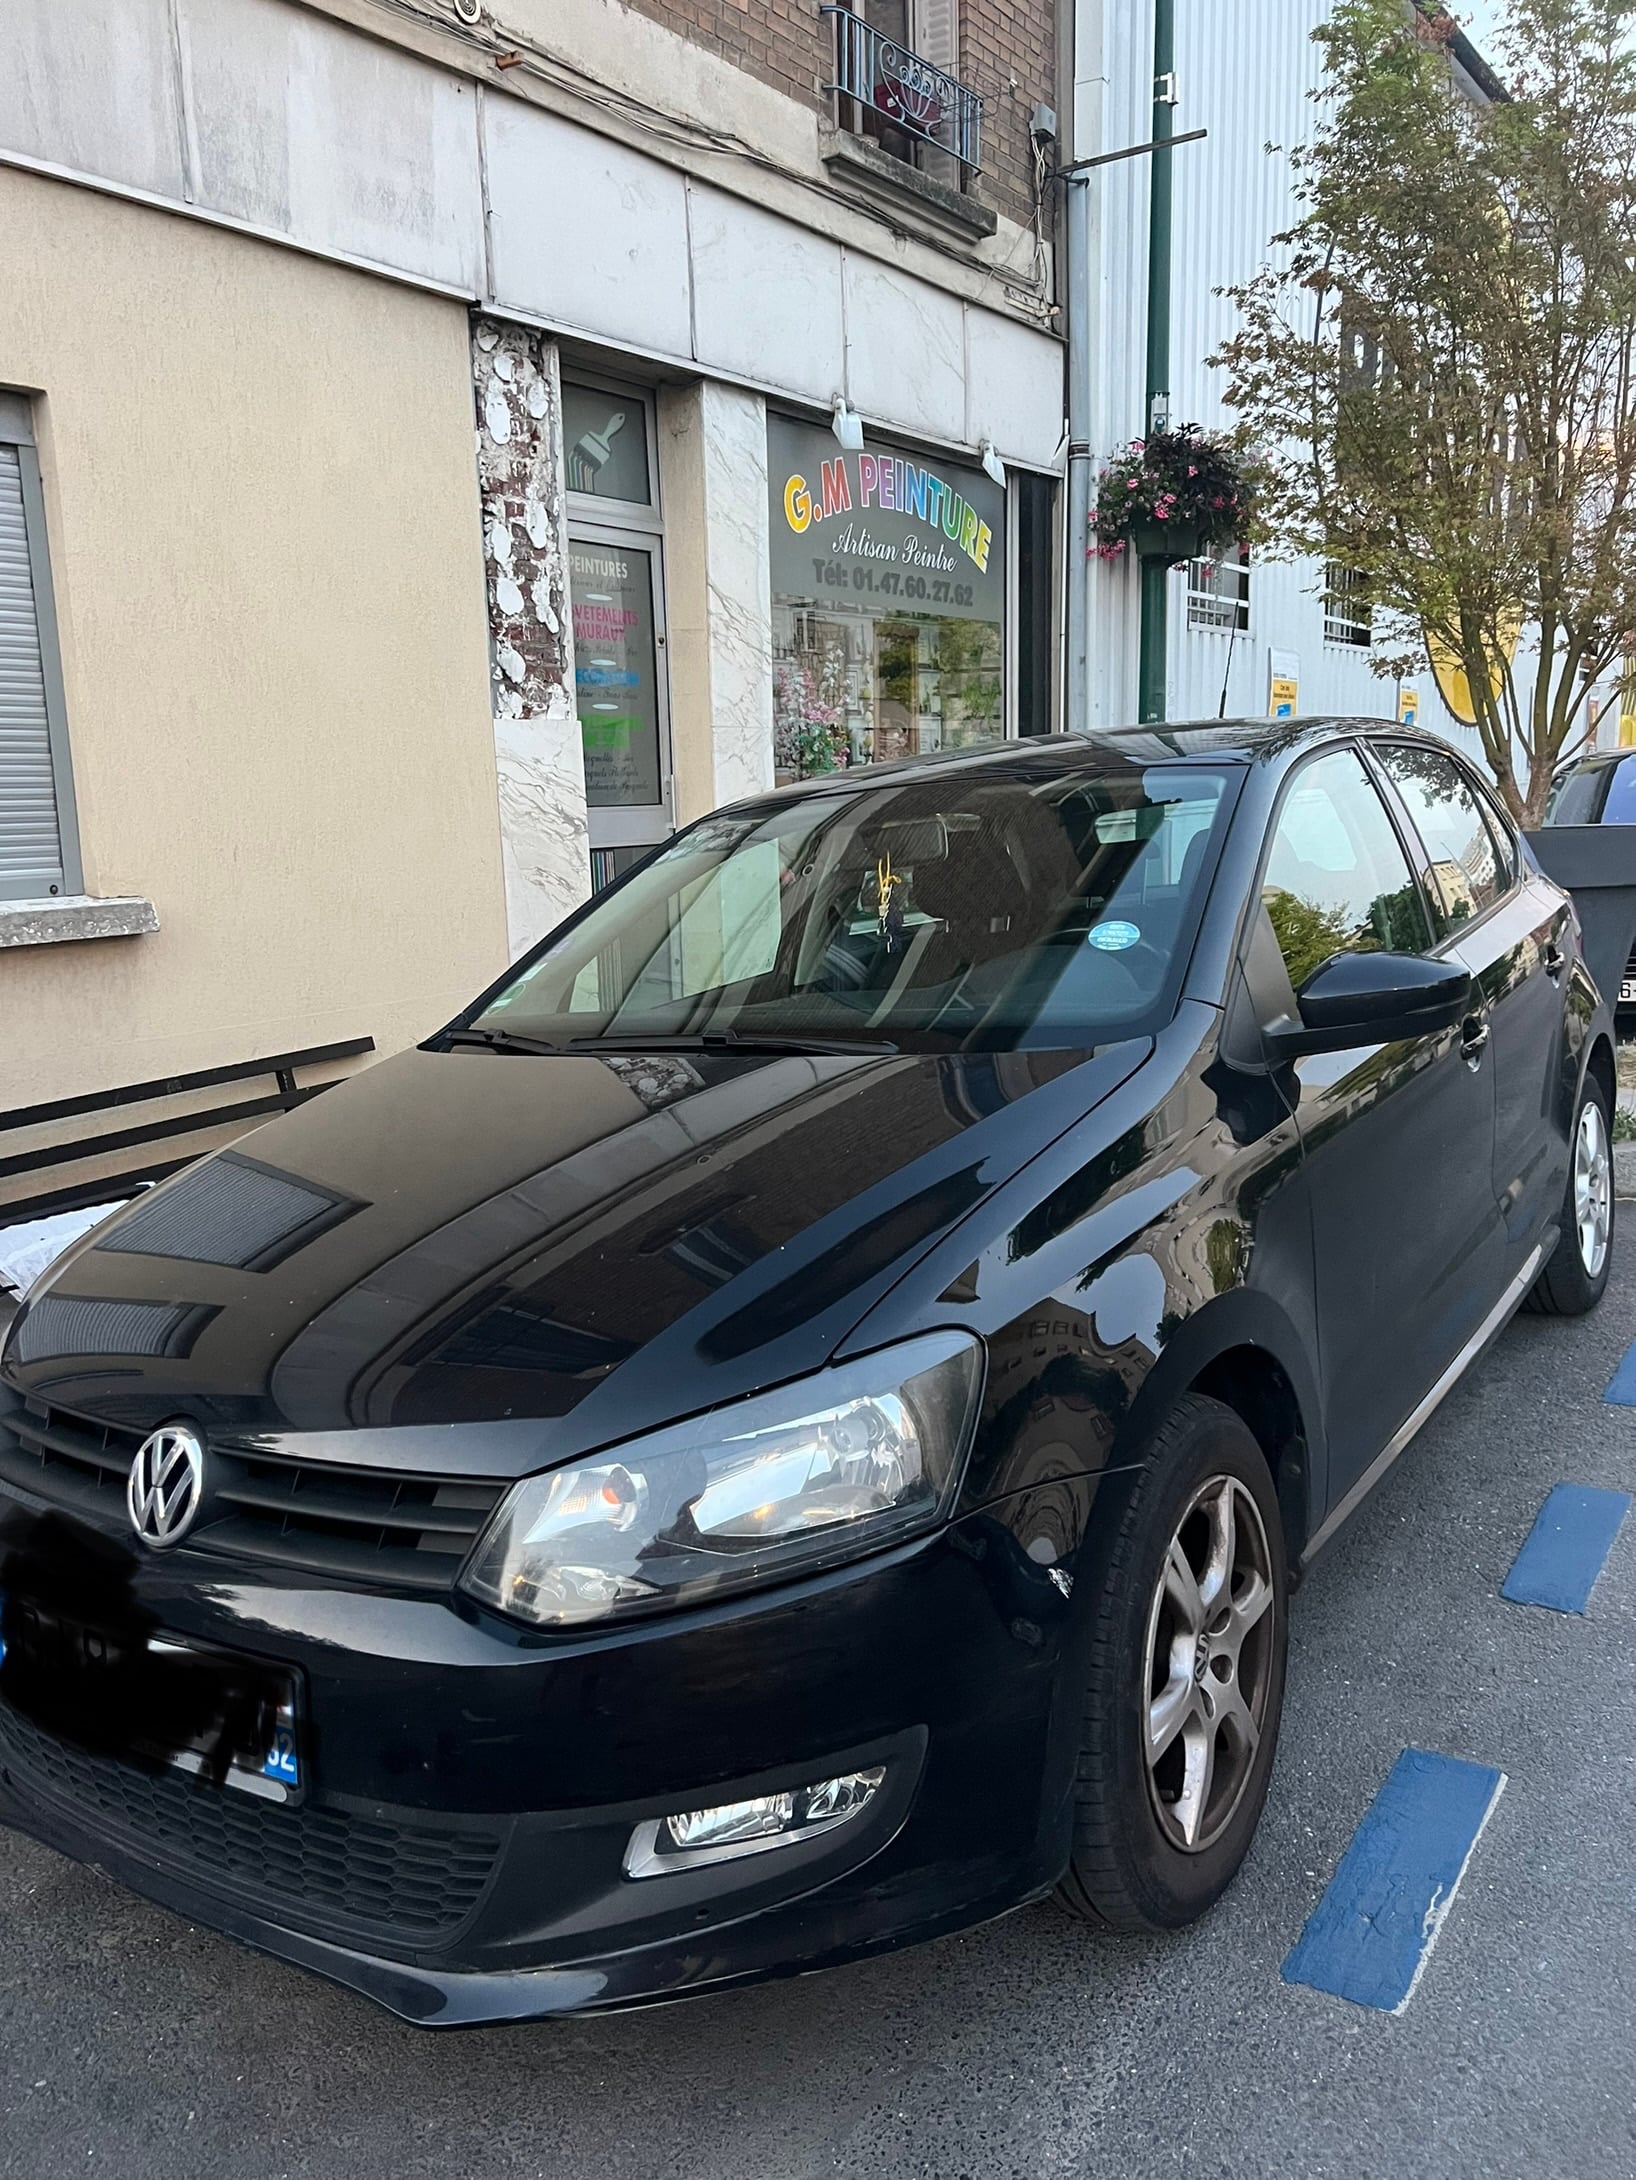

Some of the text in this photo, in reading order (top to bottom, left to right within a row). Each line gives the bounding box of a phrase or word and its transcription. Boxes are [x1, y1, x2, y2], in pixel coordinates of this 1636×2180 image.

[784, 453, 993, 575] G.M PEINTURE
[569, 553, 628, 579] PEINTURES
[832, 522, 958, 573] Artisan Peintre
[812, 558, 974, 608] Tél: 01.47.60.27.62
[572, 603, 639, 627] VETEMENTS
